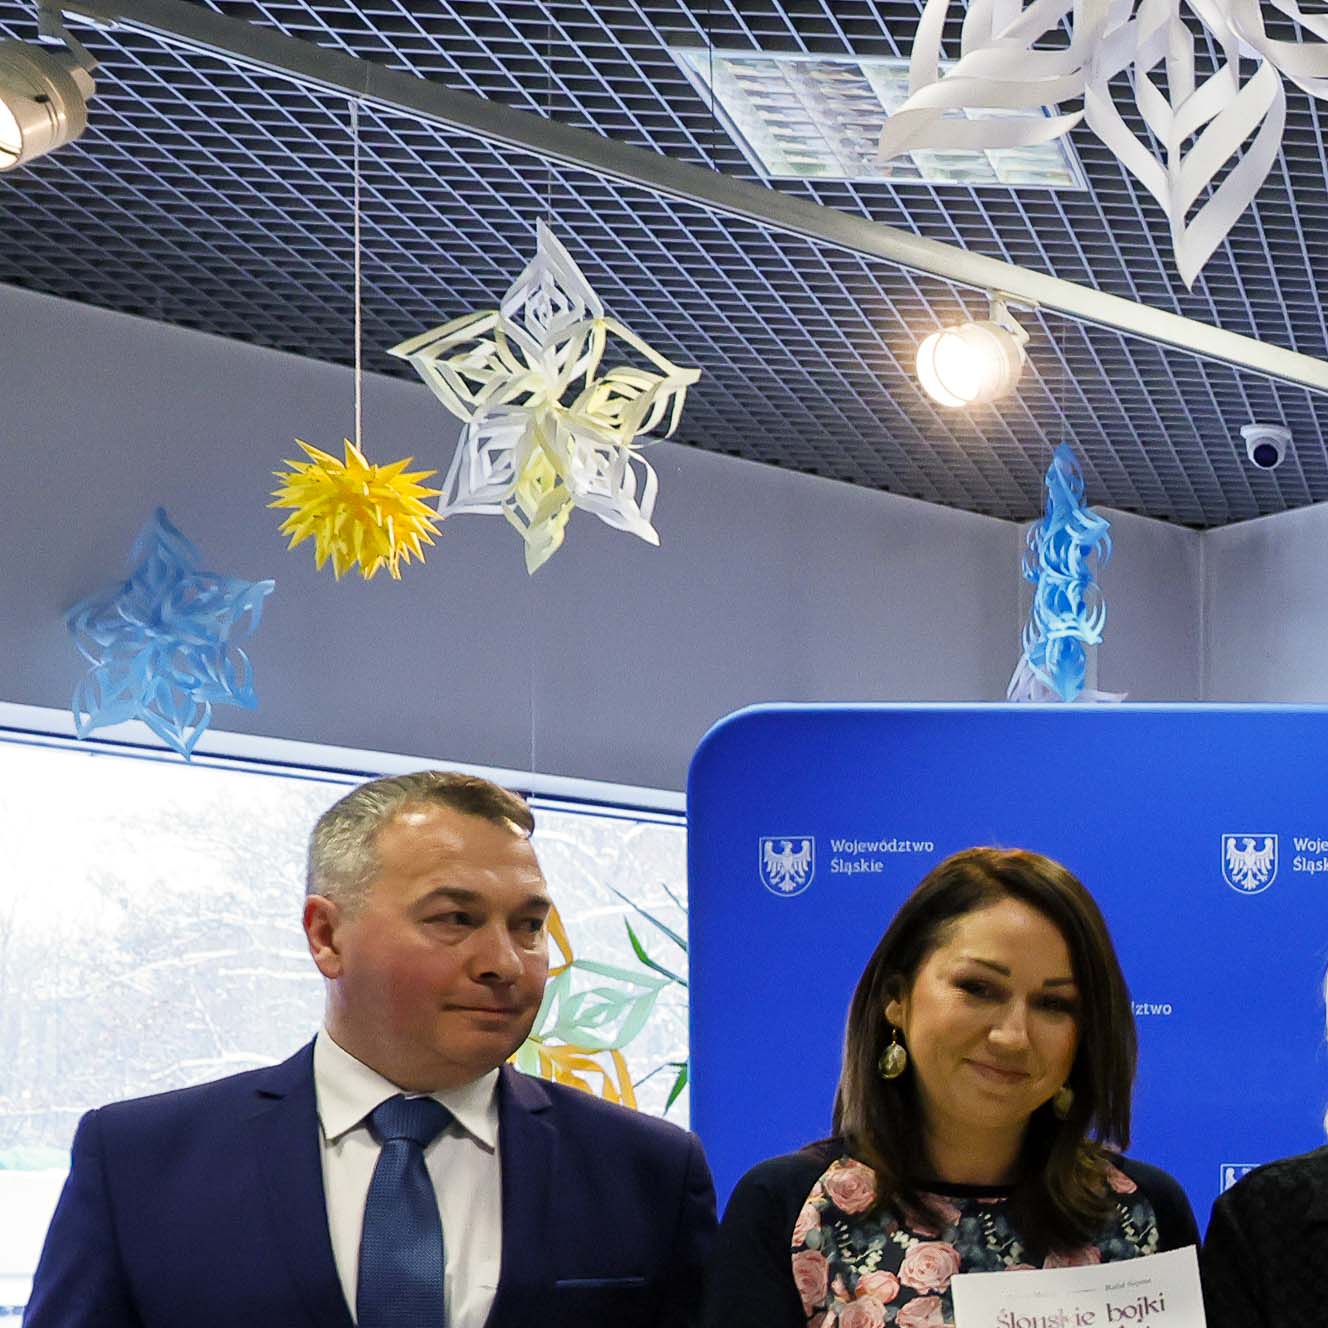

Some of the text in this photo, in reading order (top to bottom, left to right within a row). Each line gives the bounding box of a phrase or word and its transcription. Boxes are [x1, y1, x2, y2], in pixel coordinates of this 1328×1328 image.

[830, 838, 934, 854] Województwo
[830, 855, 884, 875] Śląskie
[1106, 1293, 1166, 1325] bojki
